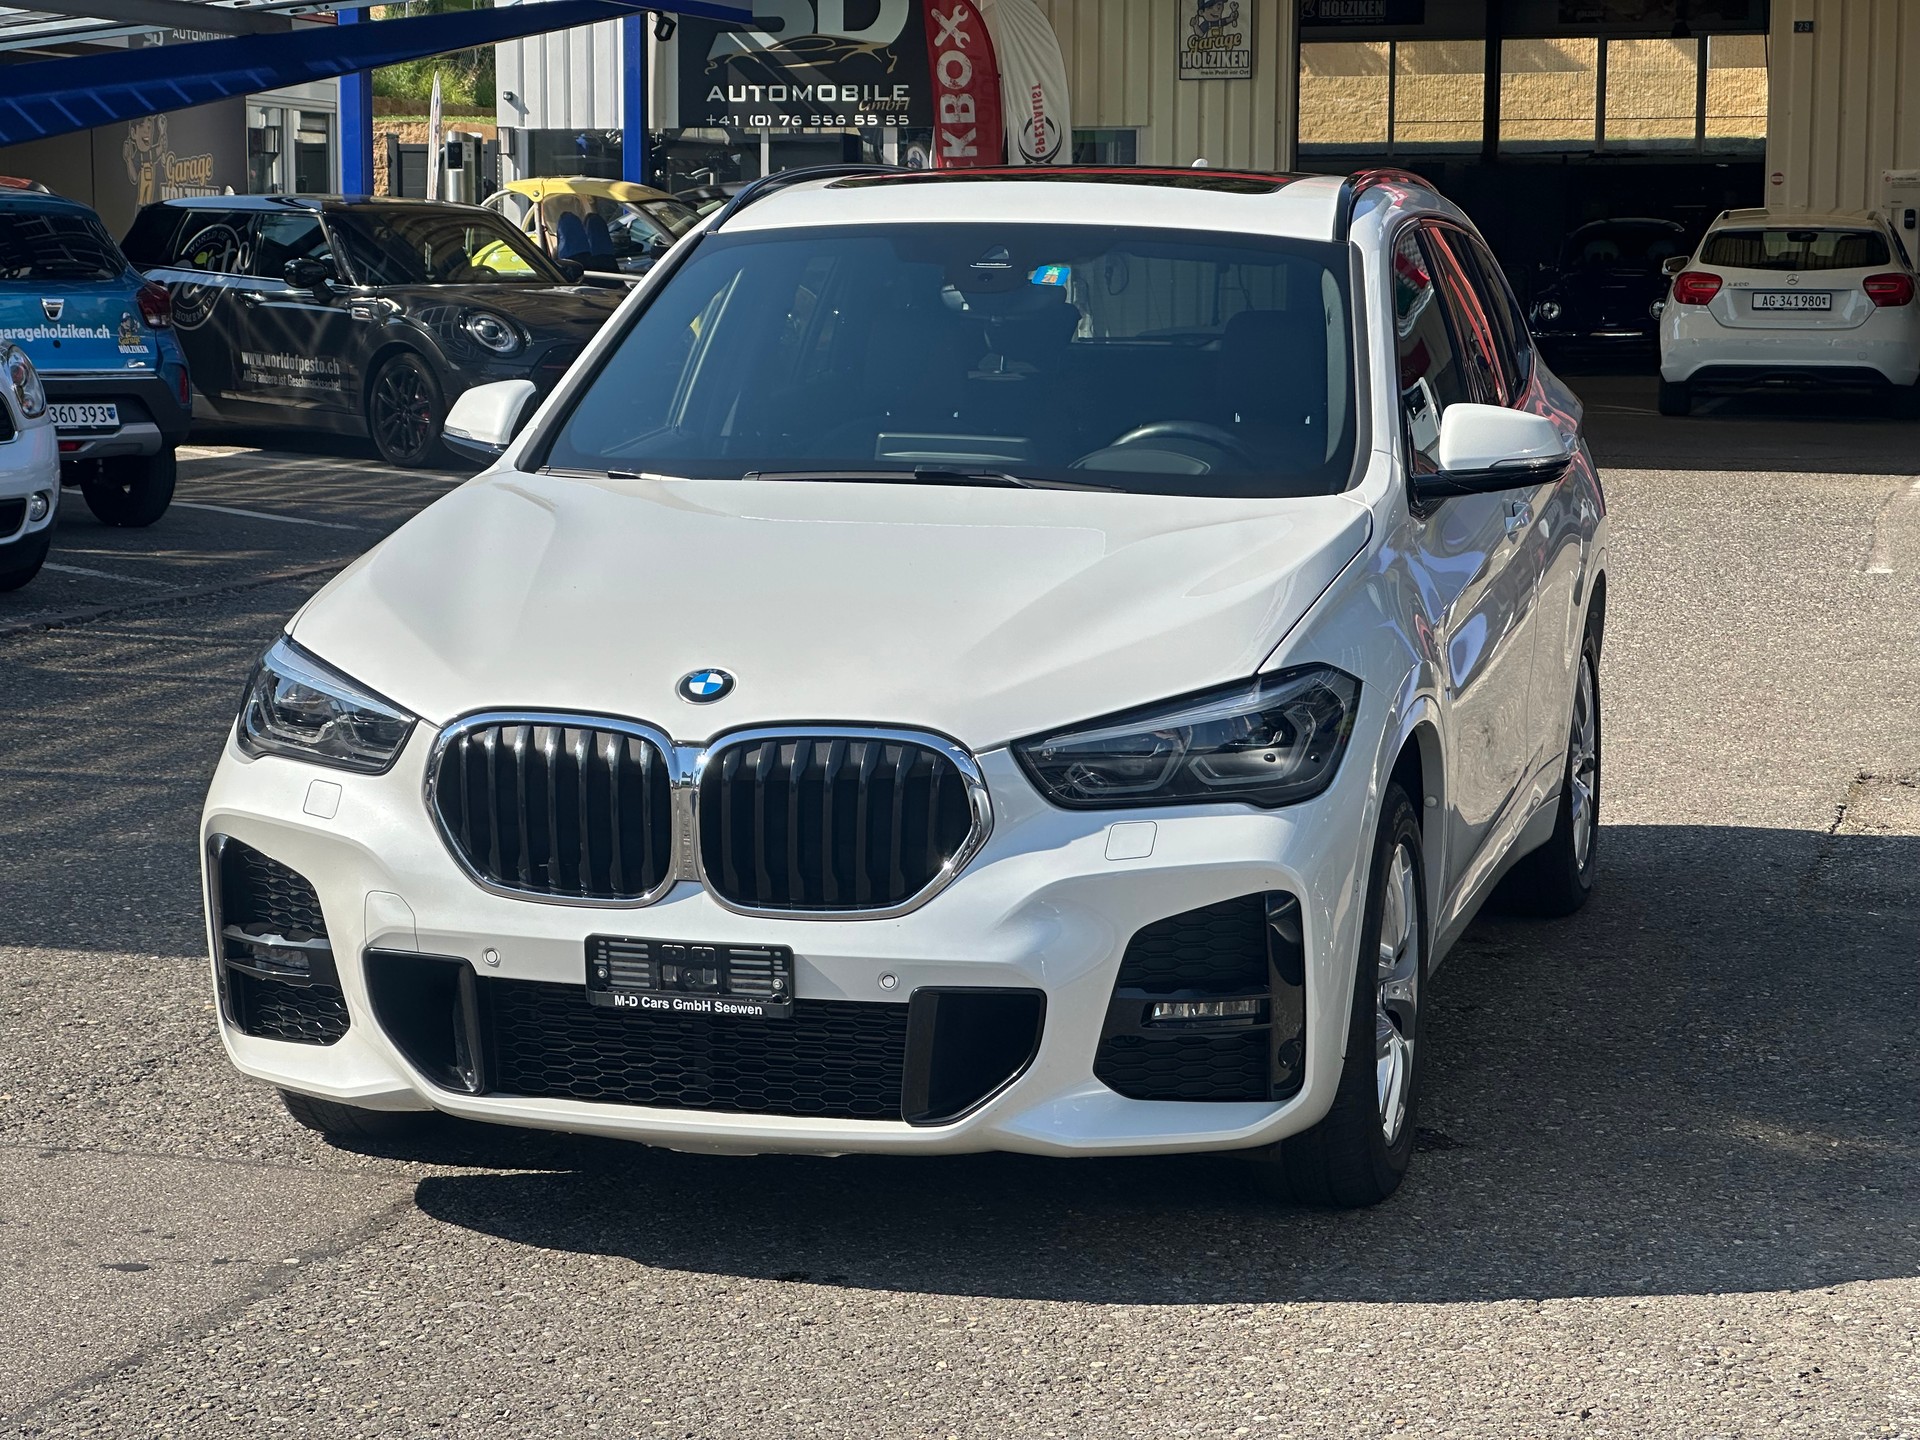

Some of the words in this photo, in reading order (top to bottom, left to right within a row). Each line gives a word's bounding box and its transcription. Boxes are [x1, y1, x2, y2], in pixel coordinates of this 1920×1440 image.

[1187, 33, 1242, 53] Garage
[1181, 51, 1249, 68] HOLZIKEN
[706, 85, 909, 102] AUTOMOBILE
[858, 97, 911, 112] GmbH
[706, 114, 739, 126] +41
[750, 114, 771, 126] (0)
[779, 114, 802, 126] 76
[810, 114, 846, 126] 556
[854, 114, 878, 126] 55
[886, 114, 910, 126] 55
[165, 153, 213, 186] Garage
[241, 352, 340, 375] www.worldofpesto.ch
[614, 995, 638, 1007] M-D
[641, 997, 670, 1009] Cars
[673, 999, 711, 1012] GmbH
[714, 1001, 763, 1015] Seewen
